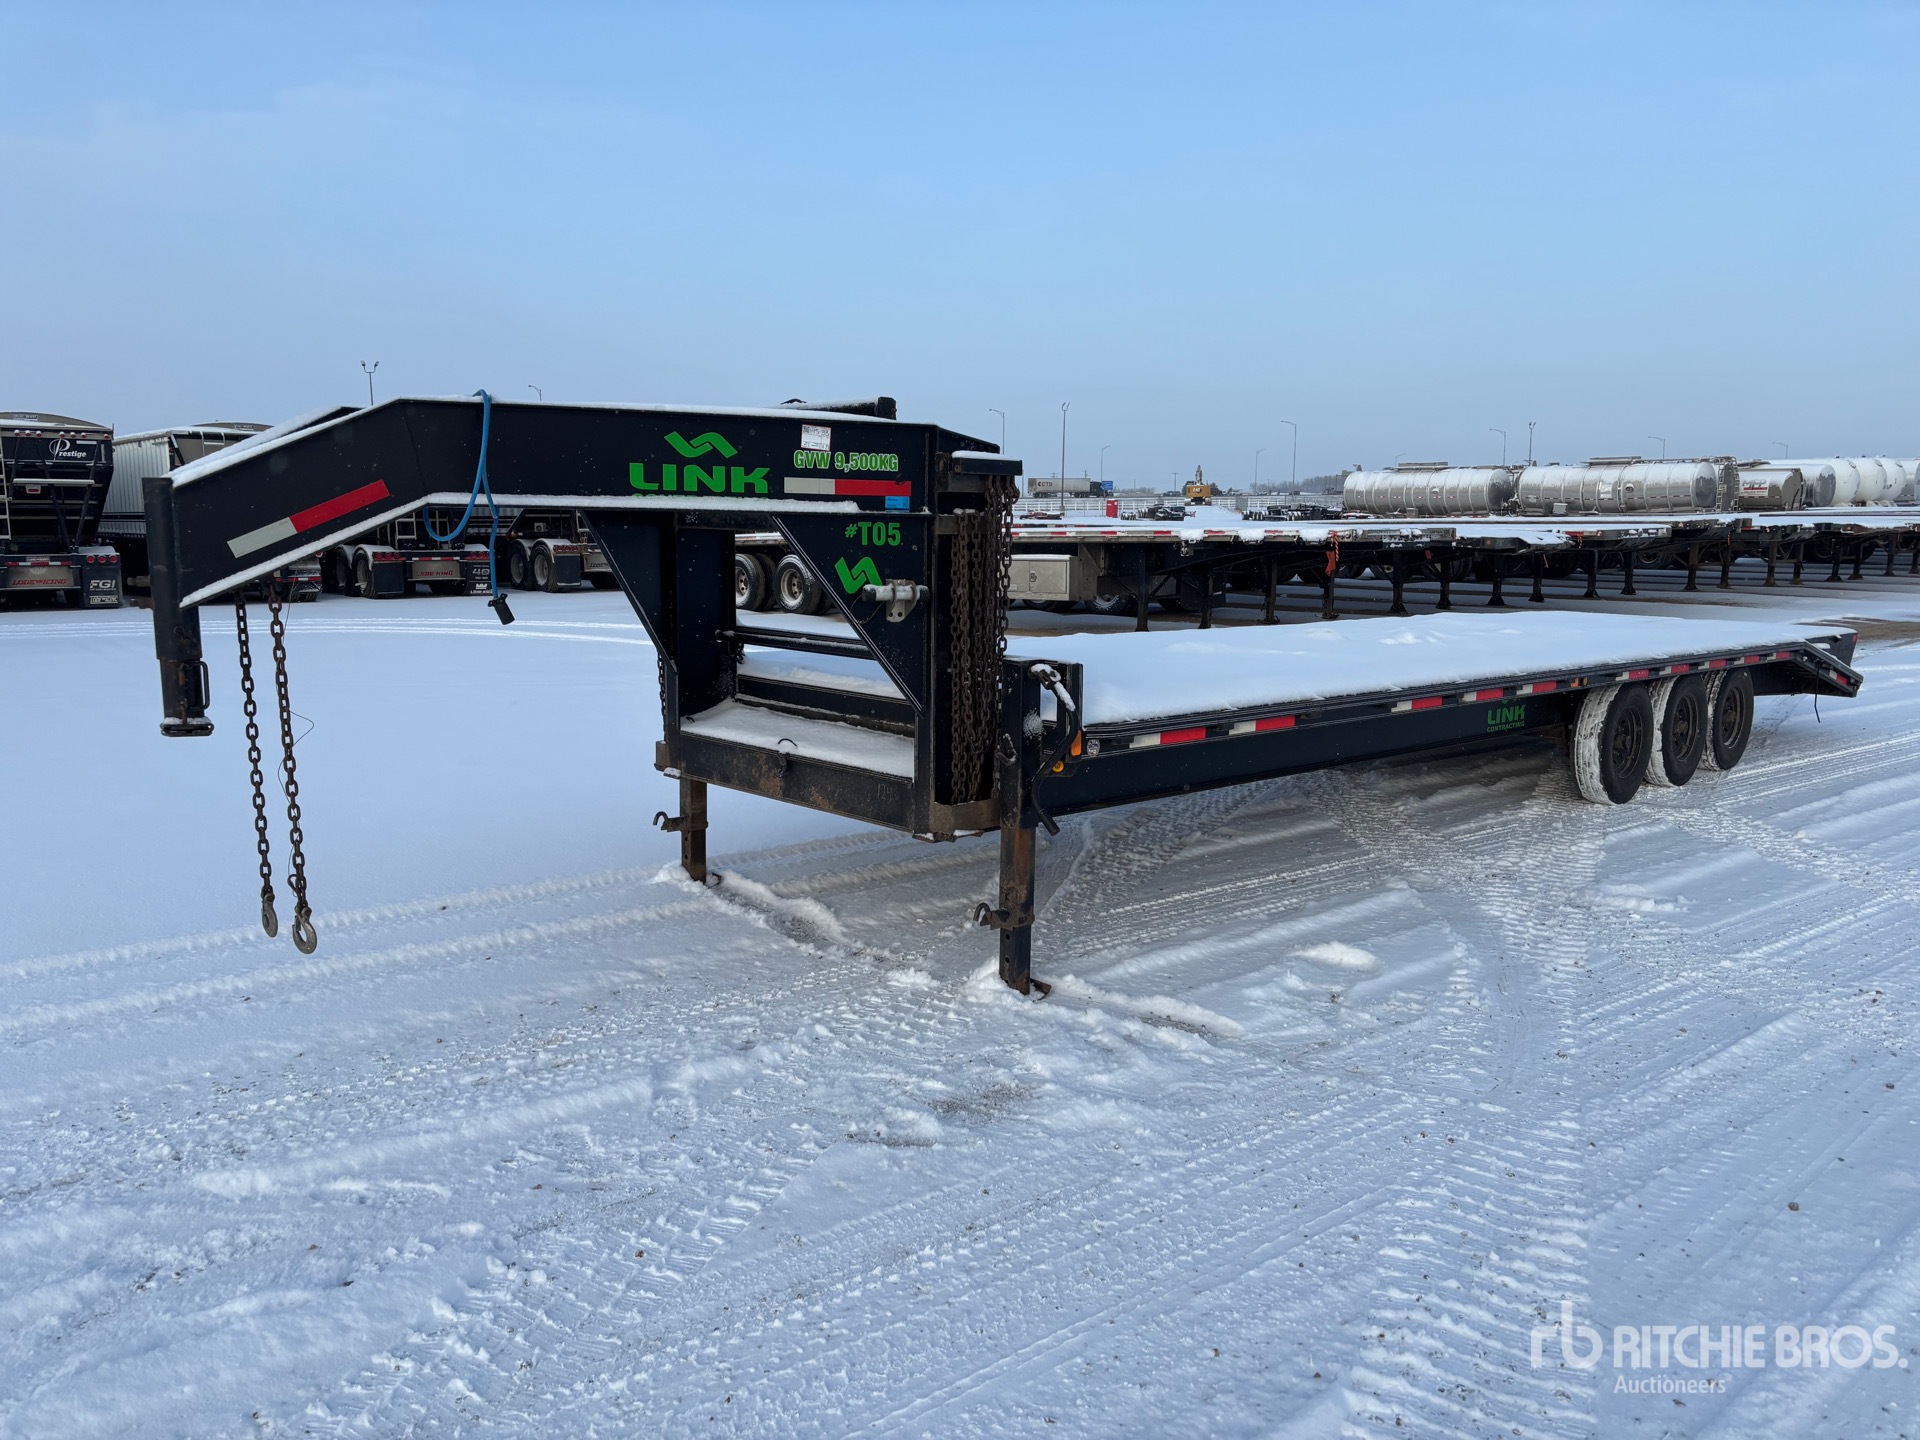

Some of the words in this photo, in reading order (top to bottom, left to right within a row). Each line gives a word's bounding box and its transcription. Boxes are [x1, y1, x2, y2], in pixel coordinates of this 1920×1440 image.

[49, 439, 87, 460] Prestige
[793, 449, 831, 469] GVW
[834, 451, 899, 472] 9,500KG
[629, 462, 770, 494] LINK
[844, 521, 901, 546] #T05
[1488, 704, 1526, 724] LINK
[1487, 721, 1525, 732] CONTRACTING
